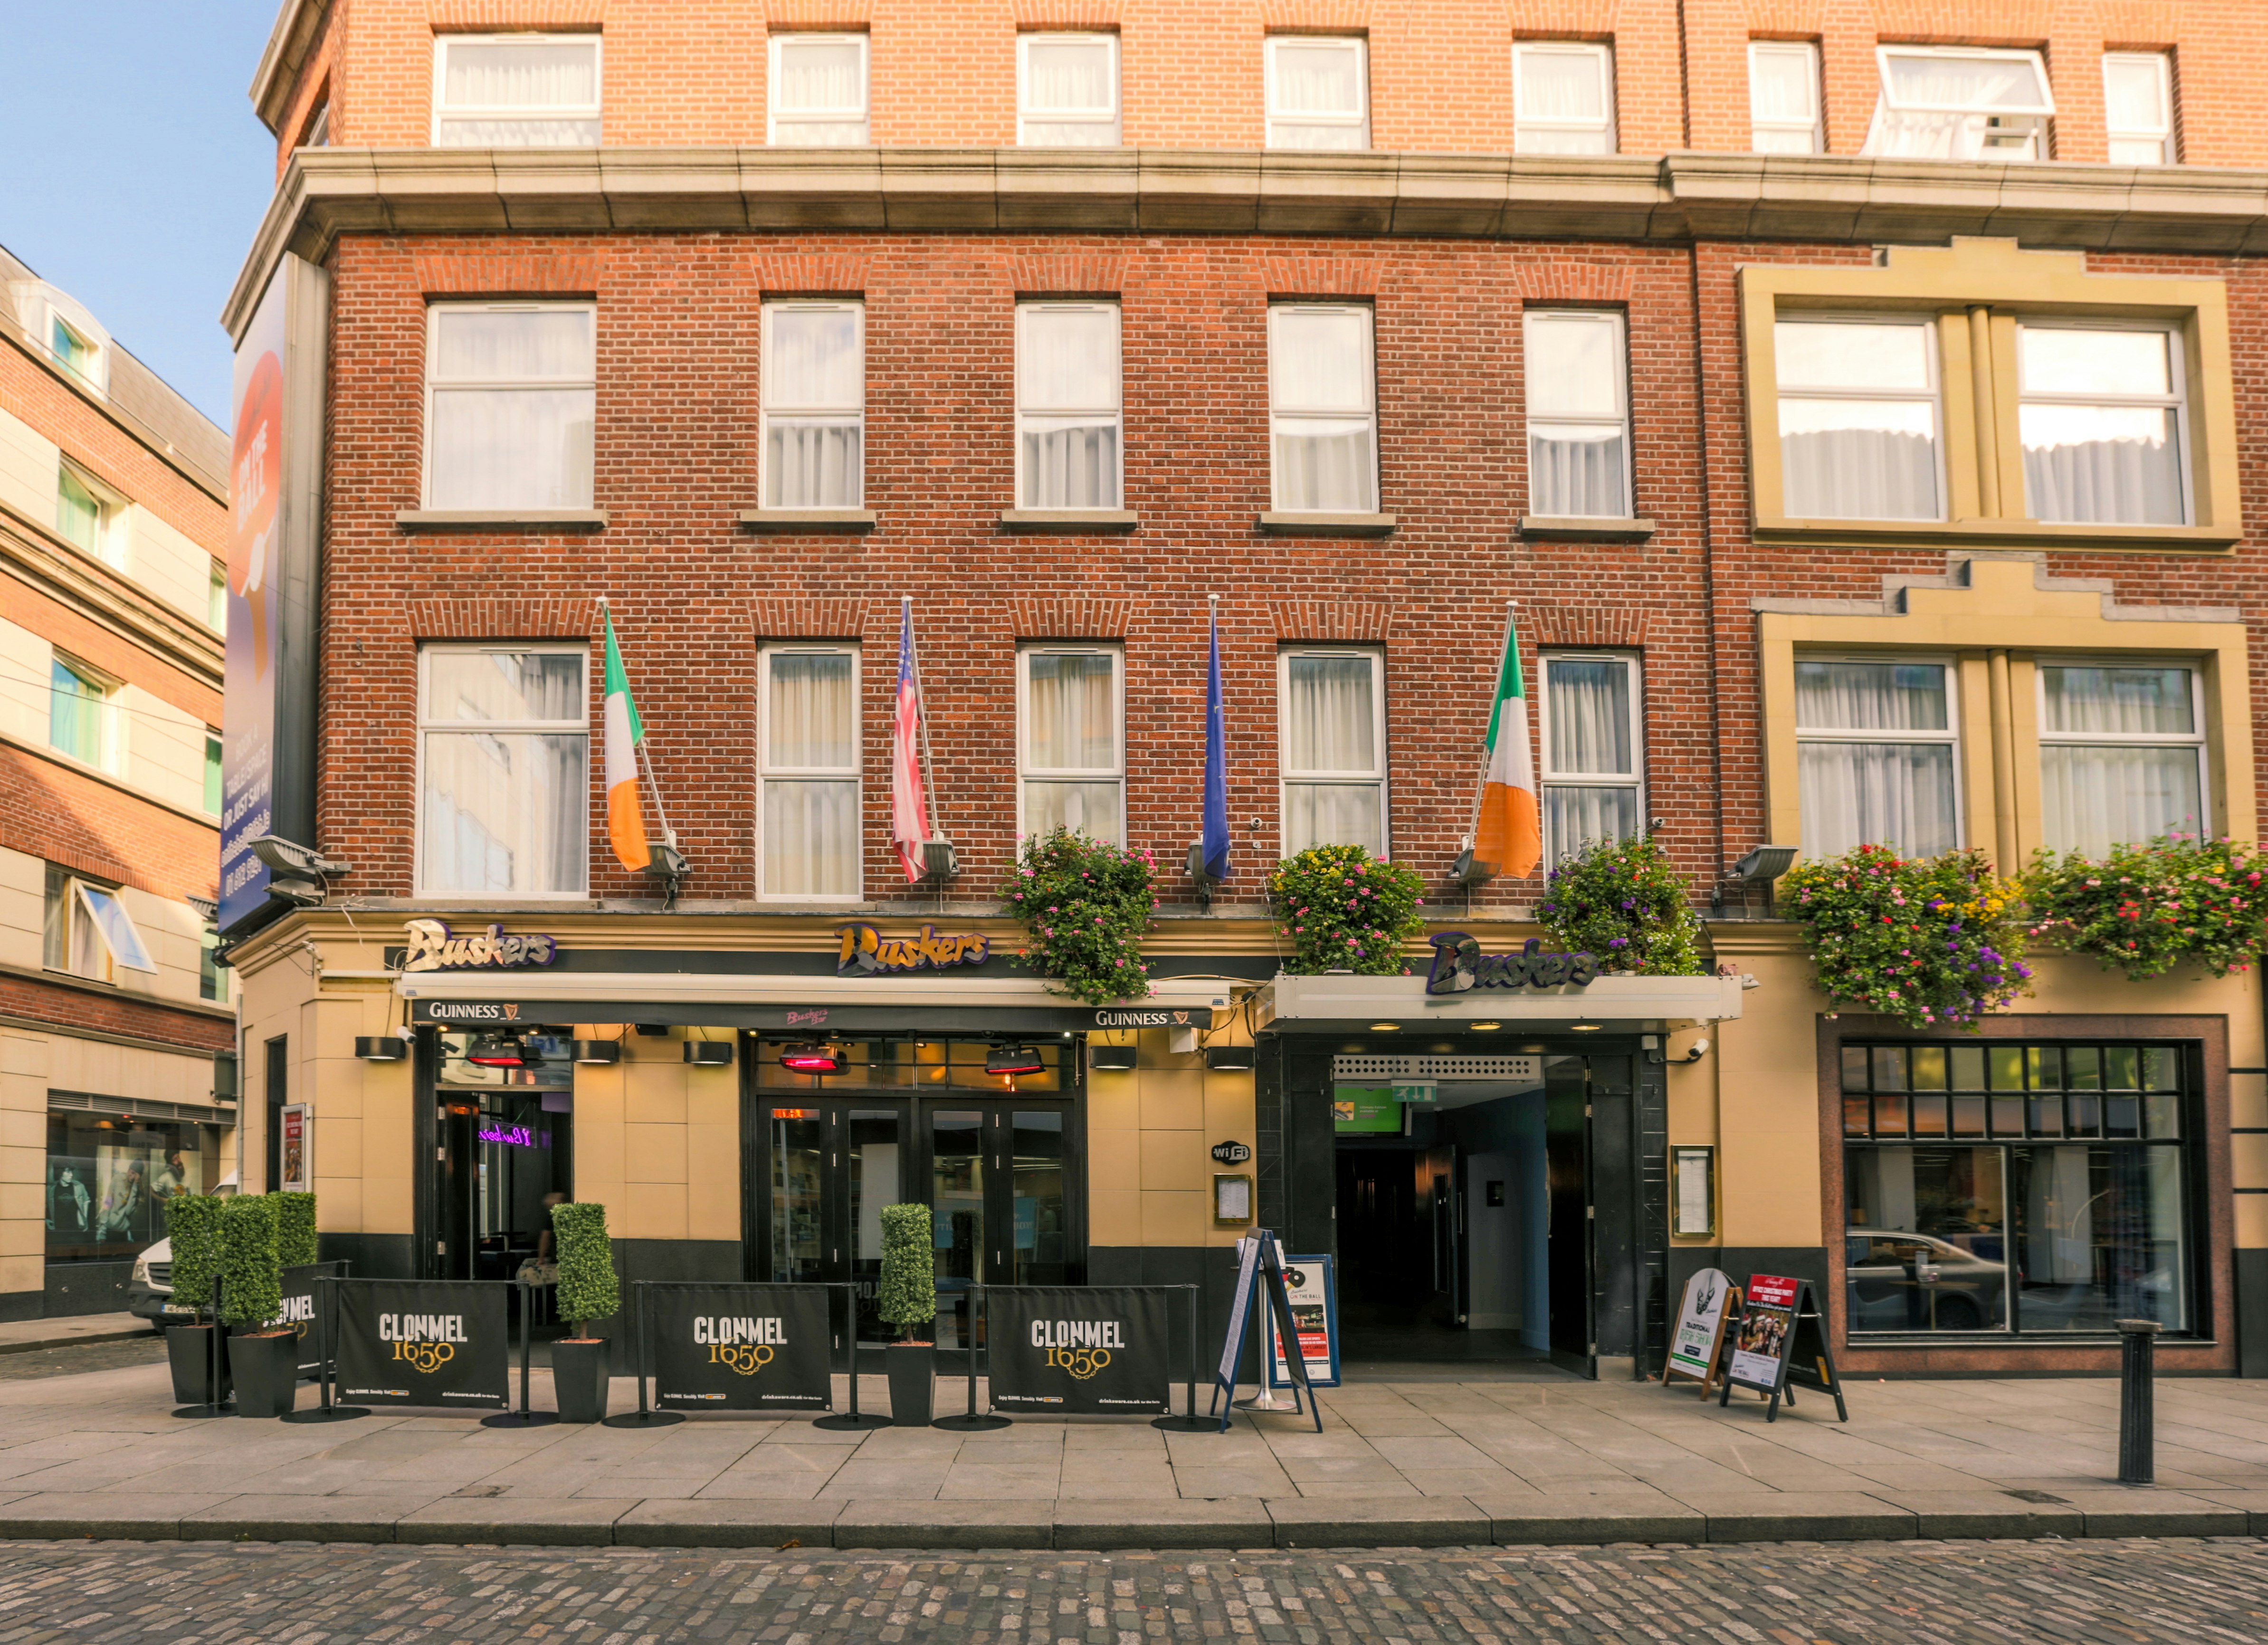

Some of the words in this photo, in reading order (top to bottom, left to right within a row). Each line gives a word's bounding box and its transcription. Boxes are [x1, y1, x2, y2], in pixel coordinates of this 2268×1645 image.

[238, 458, 265, 533] BALL
[223, 808, 233, 831] OR
[233, 792, 248, 823] JUST
[248, 779, 260, 808] SAY
[260, 772, 268, 797] HI
[403, 918, 556, 972] Buskers
[835, 923, 989, 977] Buskers
[1426, 931, 1599, 995] Buskers
[429, 1002, 499, 1018] GUINNESS
[786, 1008, 829, 1024] Buskers
[811, 1016, 826, 1025] Bar
[1096, 1011, 1168, 1025] GUINNESS
[1214, 1148, 1229, 1157] Wi
[1234, 1148, 1246, 1157] Fi
[380, 1313, 467, 1342] CLONMEL
[694, 1317, 787, 1344] CLONMEL
[1031, 1320, 1125, 1348] CLONMEL
[1686, 1322, 1710, 1333] TRADITIONAL
[1695, 1332, 1713, 1347] SHOW
[392, 1340, 455, 1368] 1650
[708, 1343, 774, 1370] 1650
[1045, 1347, 1111, 1375] 1650
